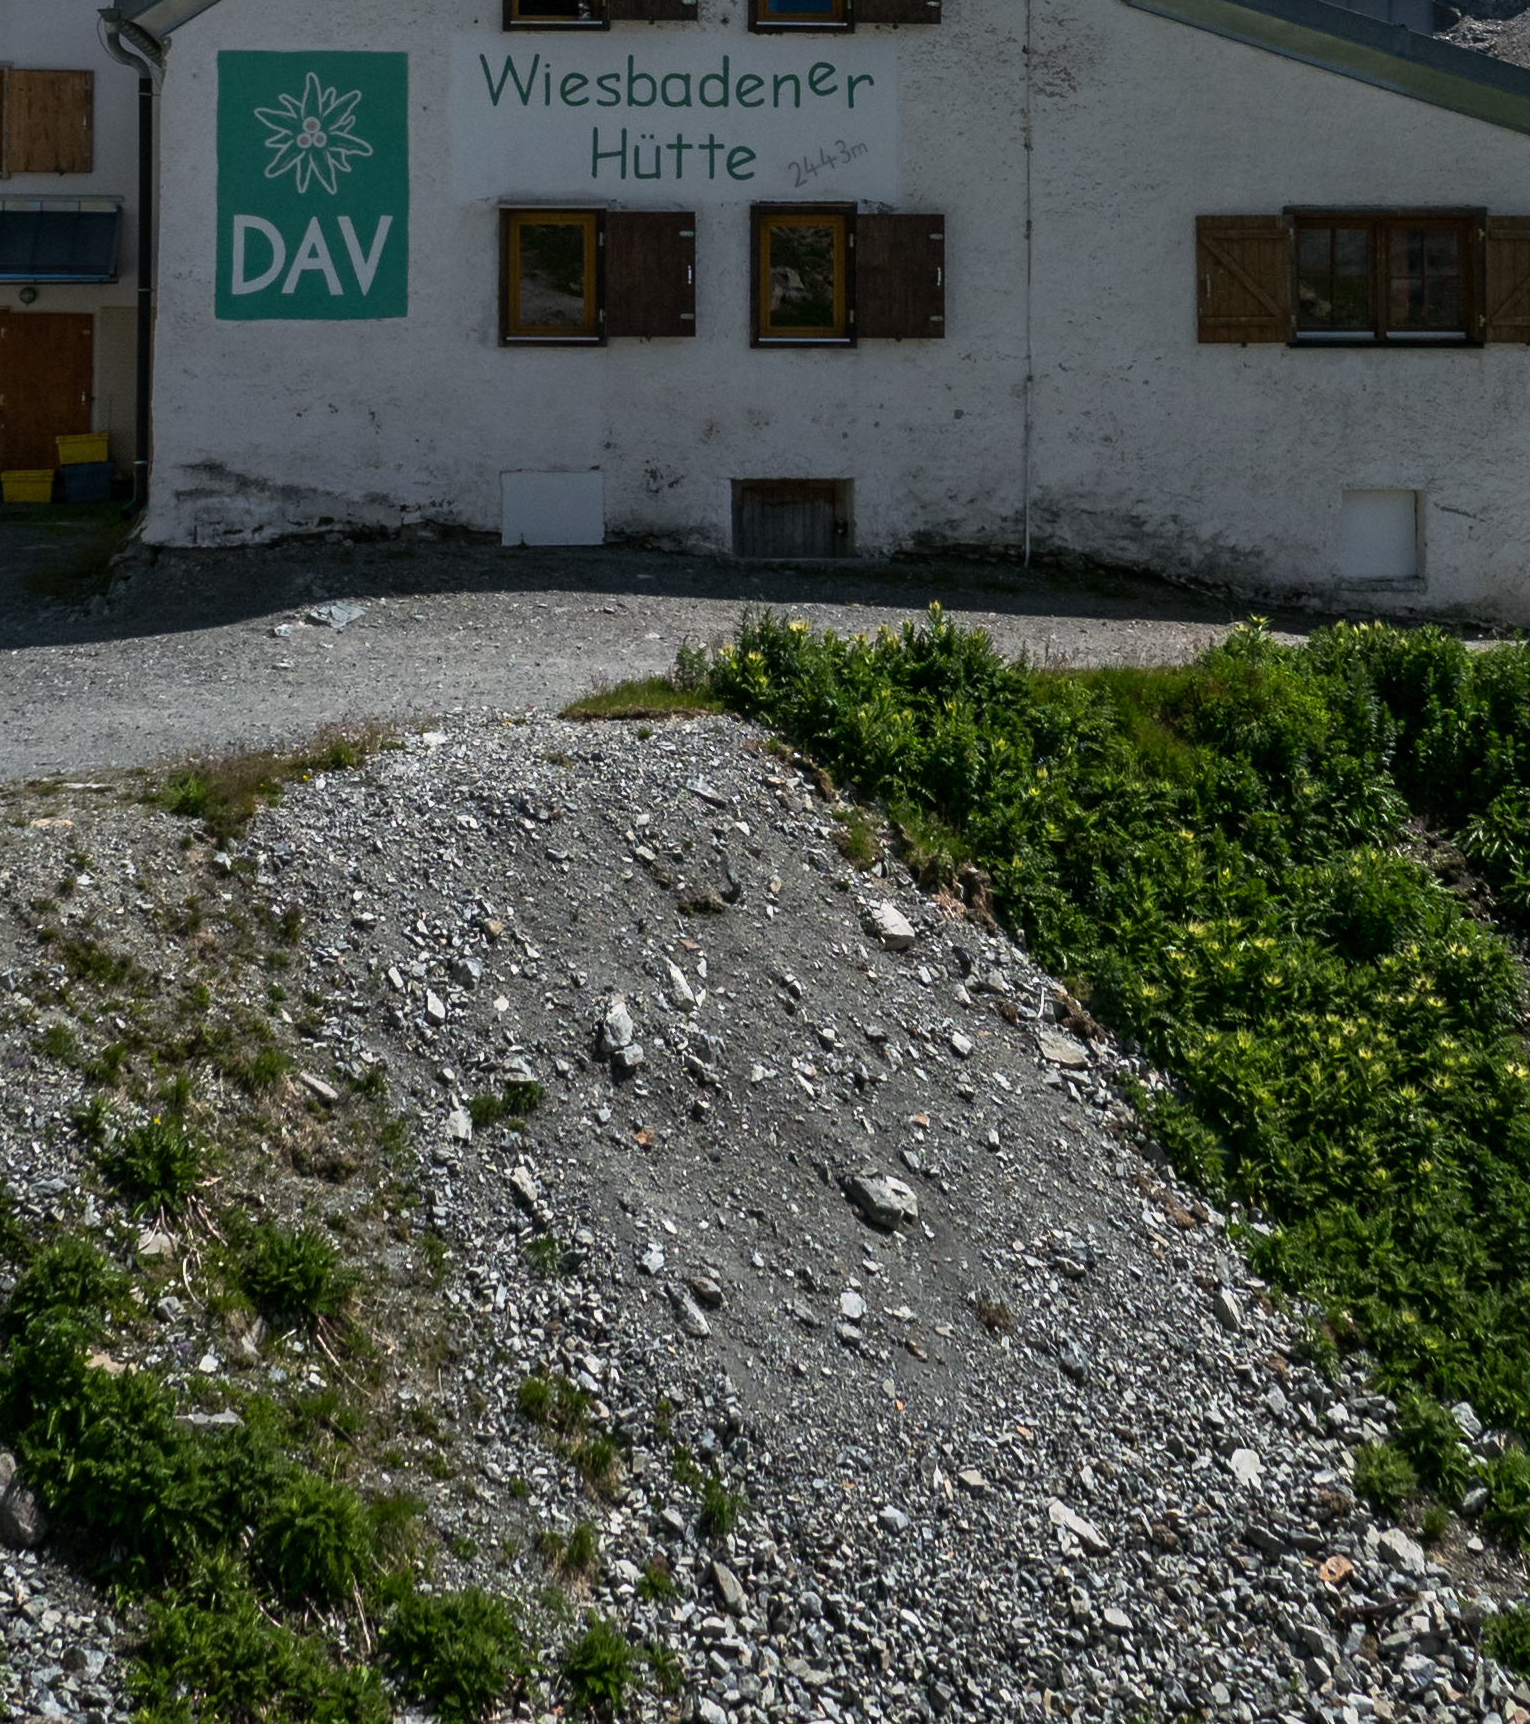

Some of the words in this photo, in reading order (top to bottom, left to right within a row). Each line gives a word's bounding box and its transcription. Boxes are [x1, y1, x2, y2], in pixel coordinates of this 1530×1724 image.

[479, 52, 875, 109] Wiesbadener
[591, 126, 757, 181] Hütte
[787, 139, 869, 188] 2443m
[231, 214, 394, 296] DAV
